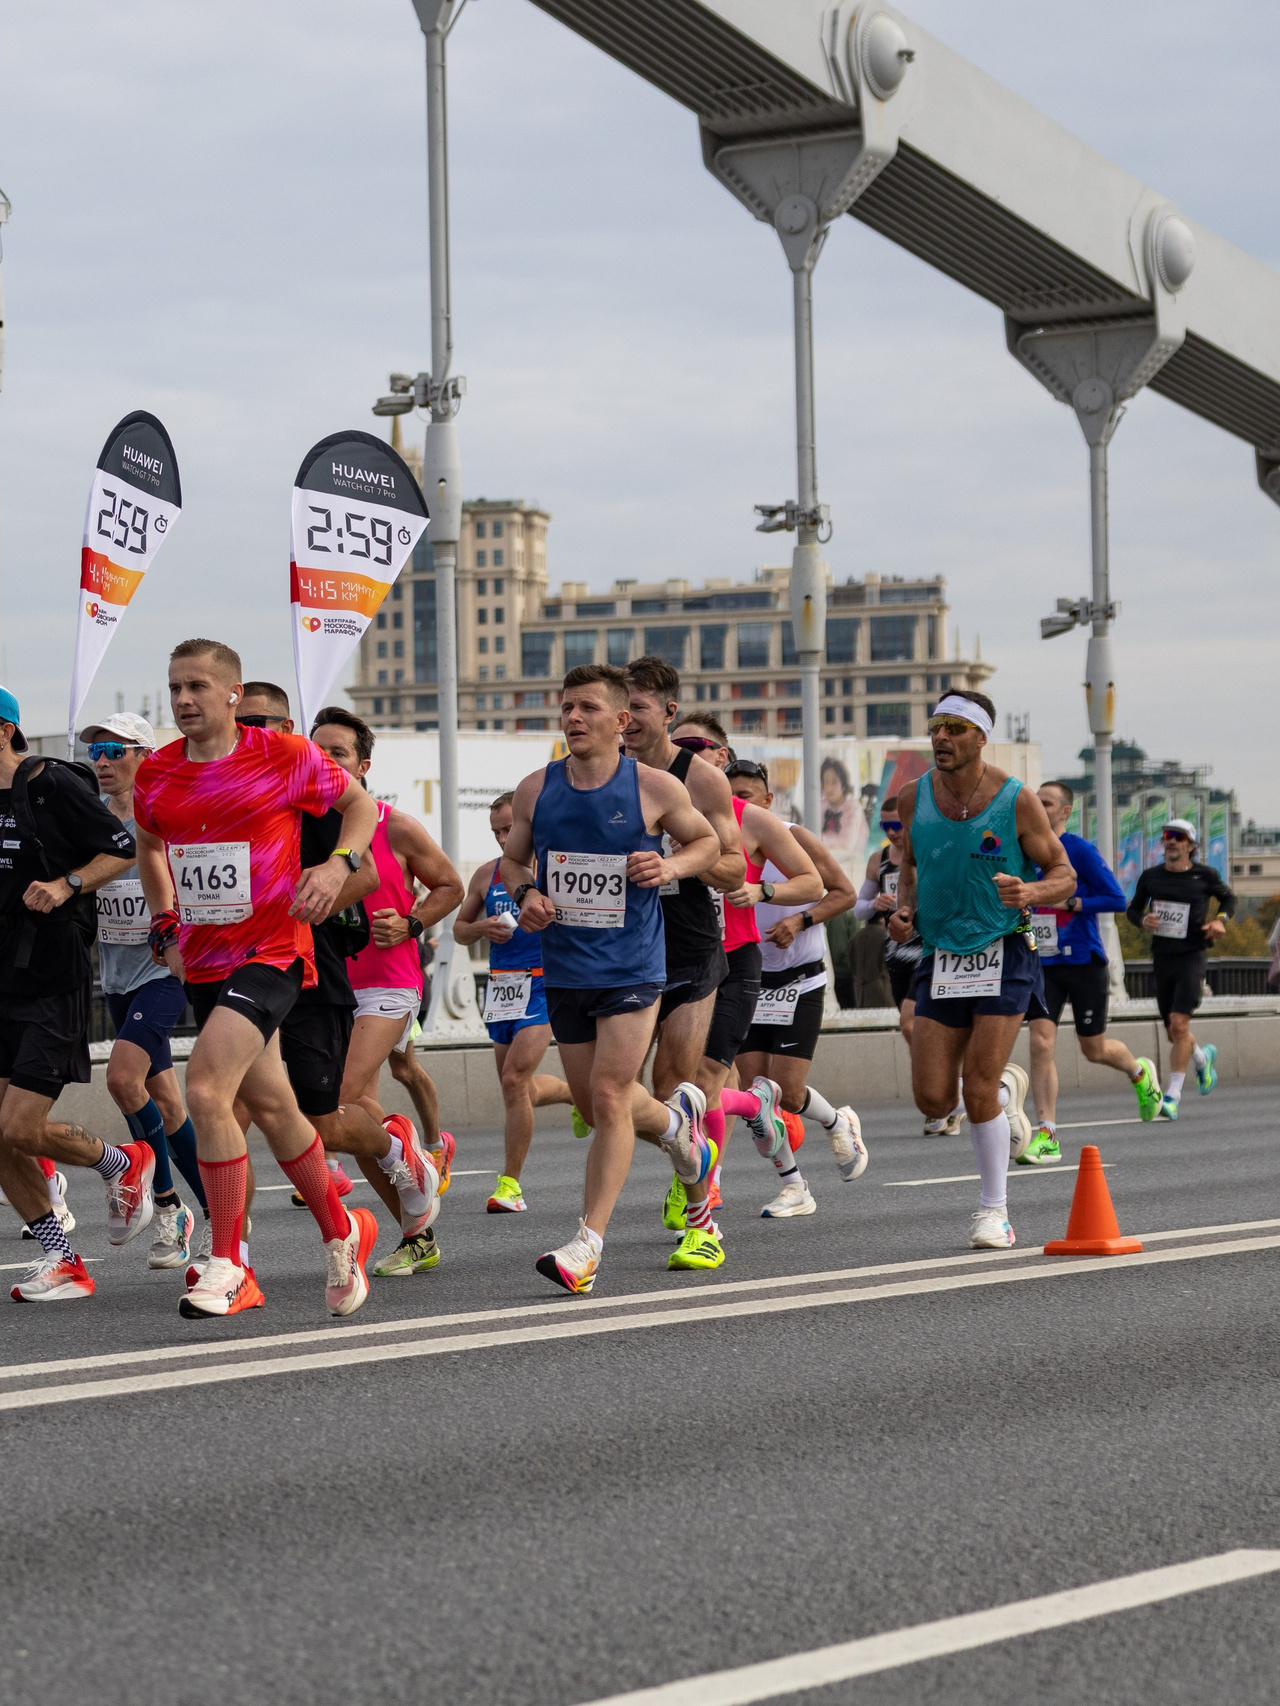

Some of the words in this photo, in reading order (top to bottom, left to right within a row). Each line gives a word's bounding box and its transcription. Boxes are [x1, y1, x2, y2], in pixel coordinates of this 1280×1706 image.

[123, 444, 163, 476] HUAWEI
[122, 460, 140, 477] WATCH
[139, 470, 147, 480] GT
[151, 475, 161, 487] Pro
[332, 462, 395, 489] HUAWEI
[332, 477, 364, 493] WATCH
[364, 485, 375, 495] GT
[383, 488, 397, 500] Pro
[307, 505, 392, 566] 2:59
[300, 578, 337, 600] 4:15
[341, 591, 358, 602] КМ
[324, 623, 362, 633] МОСКОВСКИЙ
[324, 629, 356, 637] МАРАФОН
[181, 864, 238, 890] 4163
[551, 870, 623, 897] 19093
[96, 896, 146, 917] 20107
[198, 893, 221, 901] РОМАН
[576, 897, 594, 905] ИВАН
[184, 908, 193, 922] B
[101, 929, 108, 941] B
[939, 951, 1000, 973] 17304
[493, 985, 524, 1002] 7304
[937, 986, 946, 996] B
